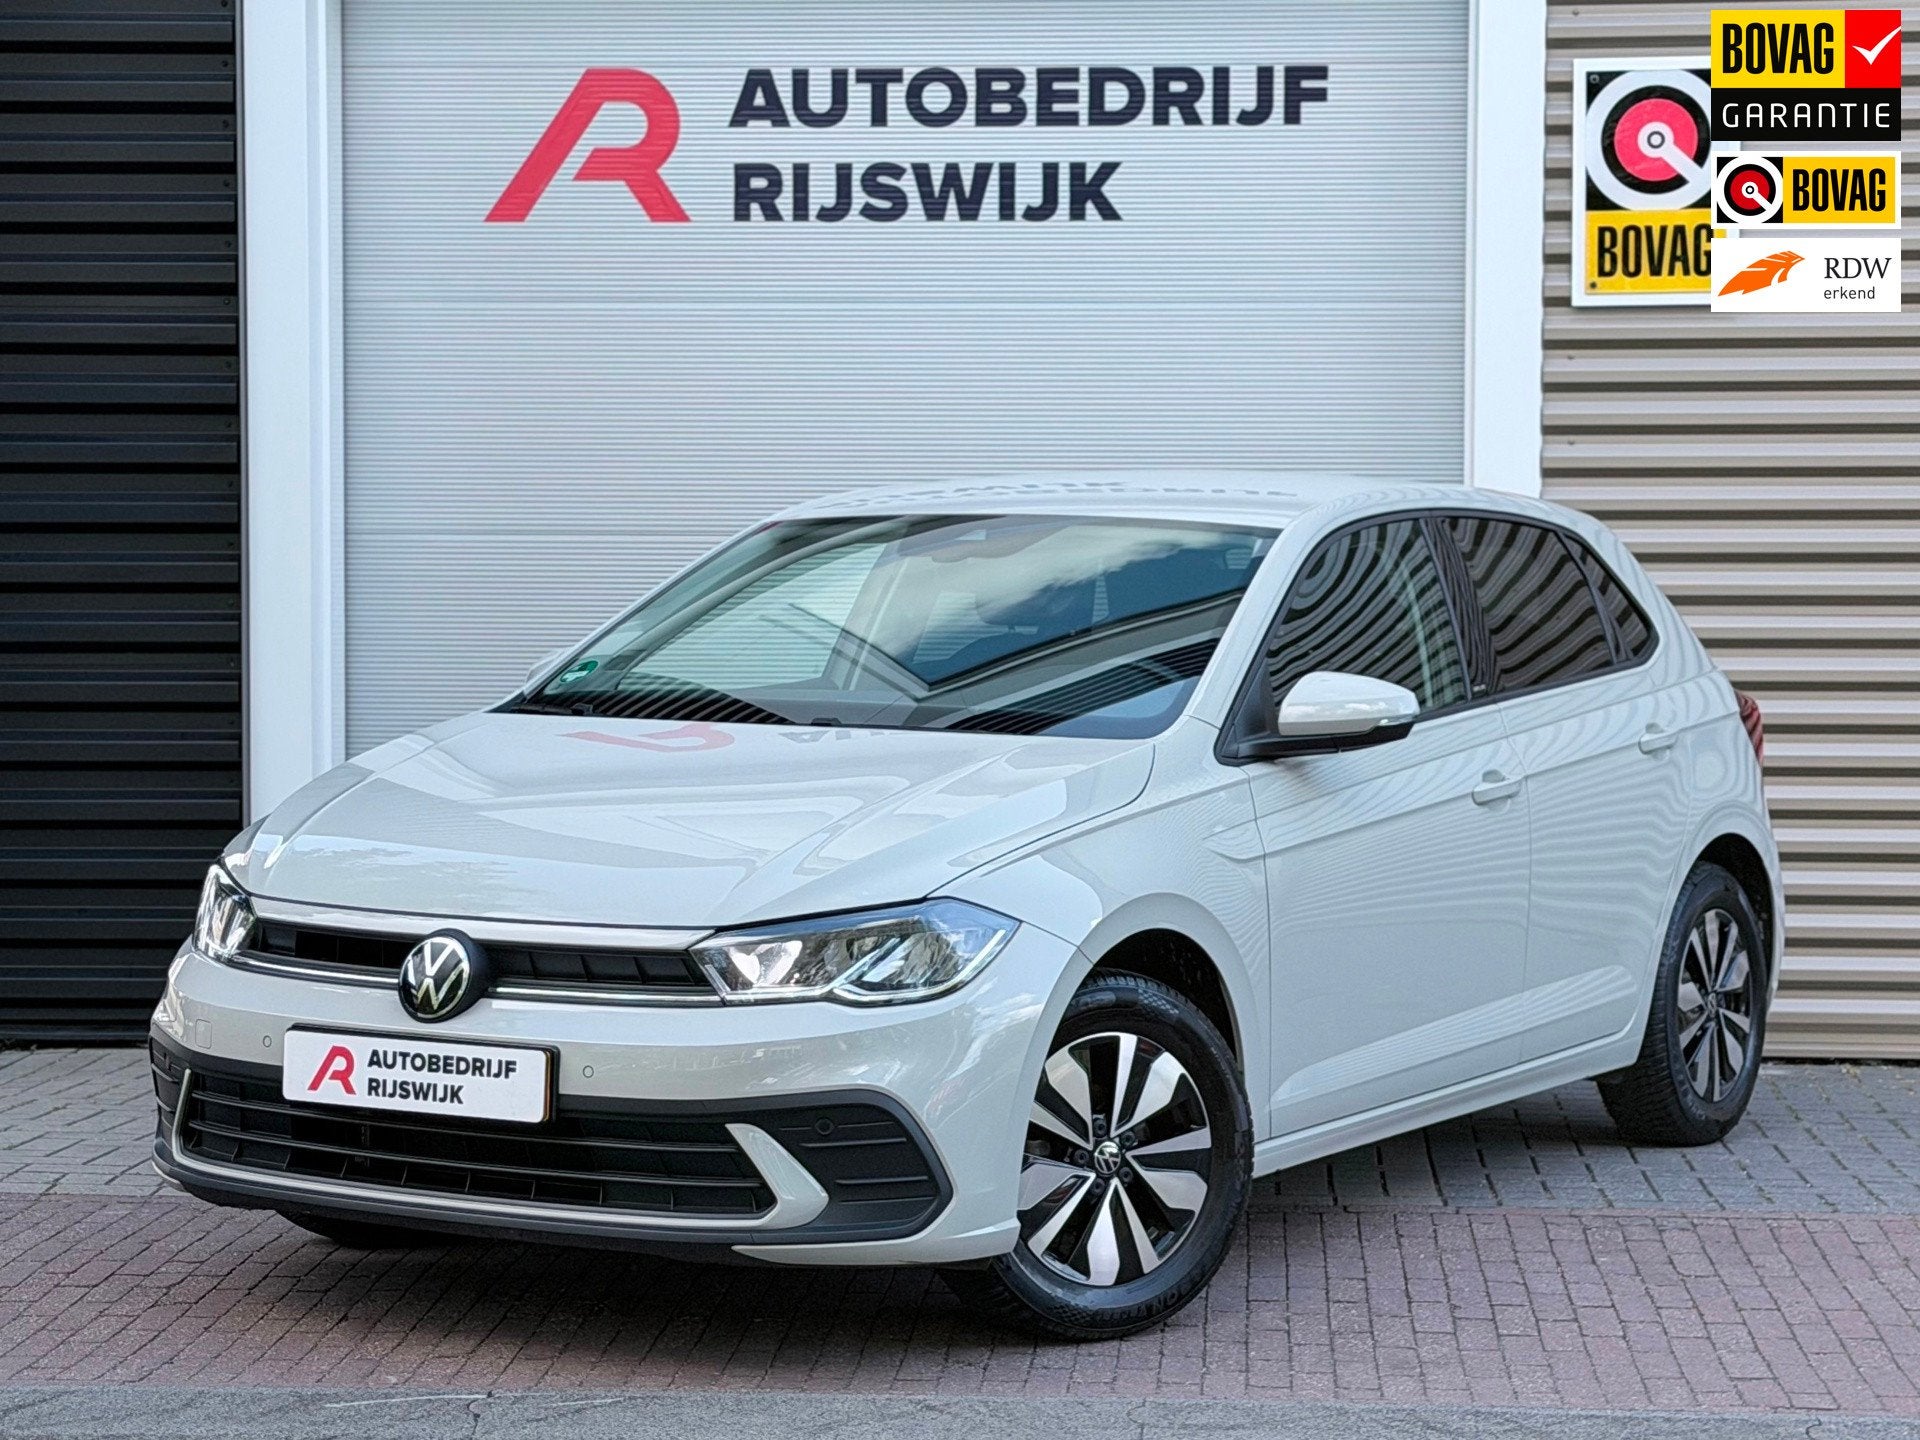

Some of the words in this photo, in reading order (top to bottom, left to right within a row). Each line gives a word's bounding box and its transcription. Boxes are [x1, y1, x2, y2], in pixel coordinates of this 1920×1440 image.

[728, 66, 1329, 128] AUTOBEDRIJF
[733, 162, 1122, 222] RIJSWIJK
[1597, 223, 1714, 278] BOVAG
[367, 1049, 517, 1079] AUTOBEDRIJF
[367, 1078, 464, 1105] RIJSWIJK
